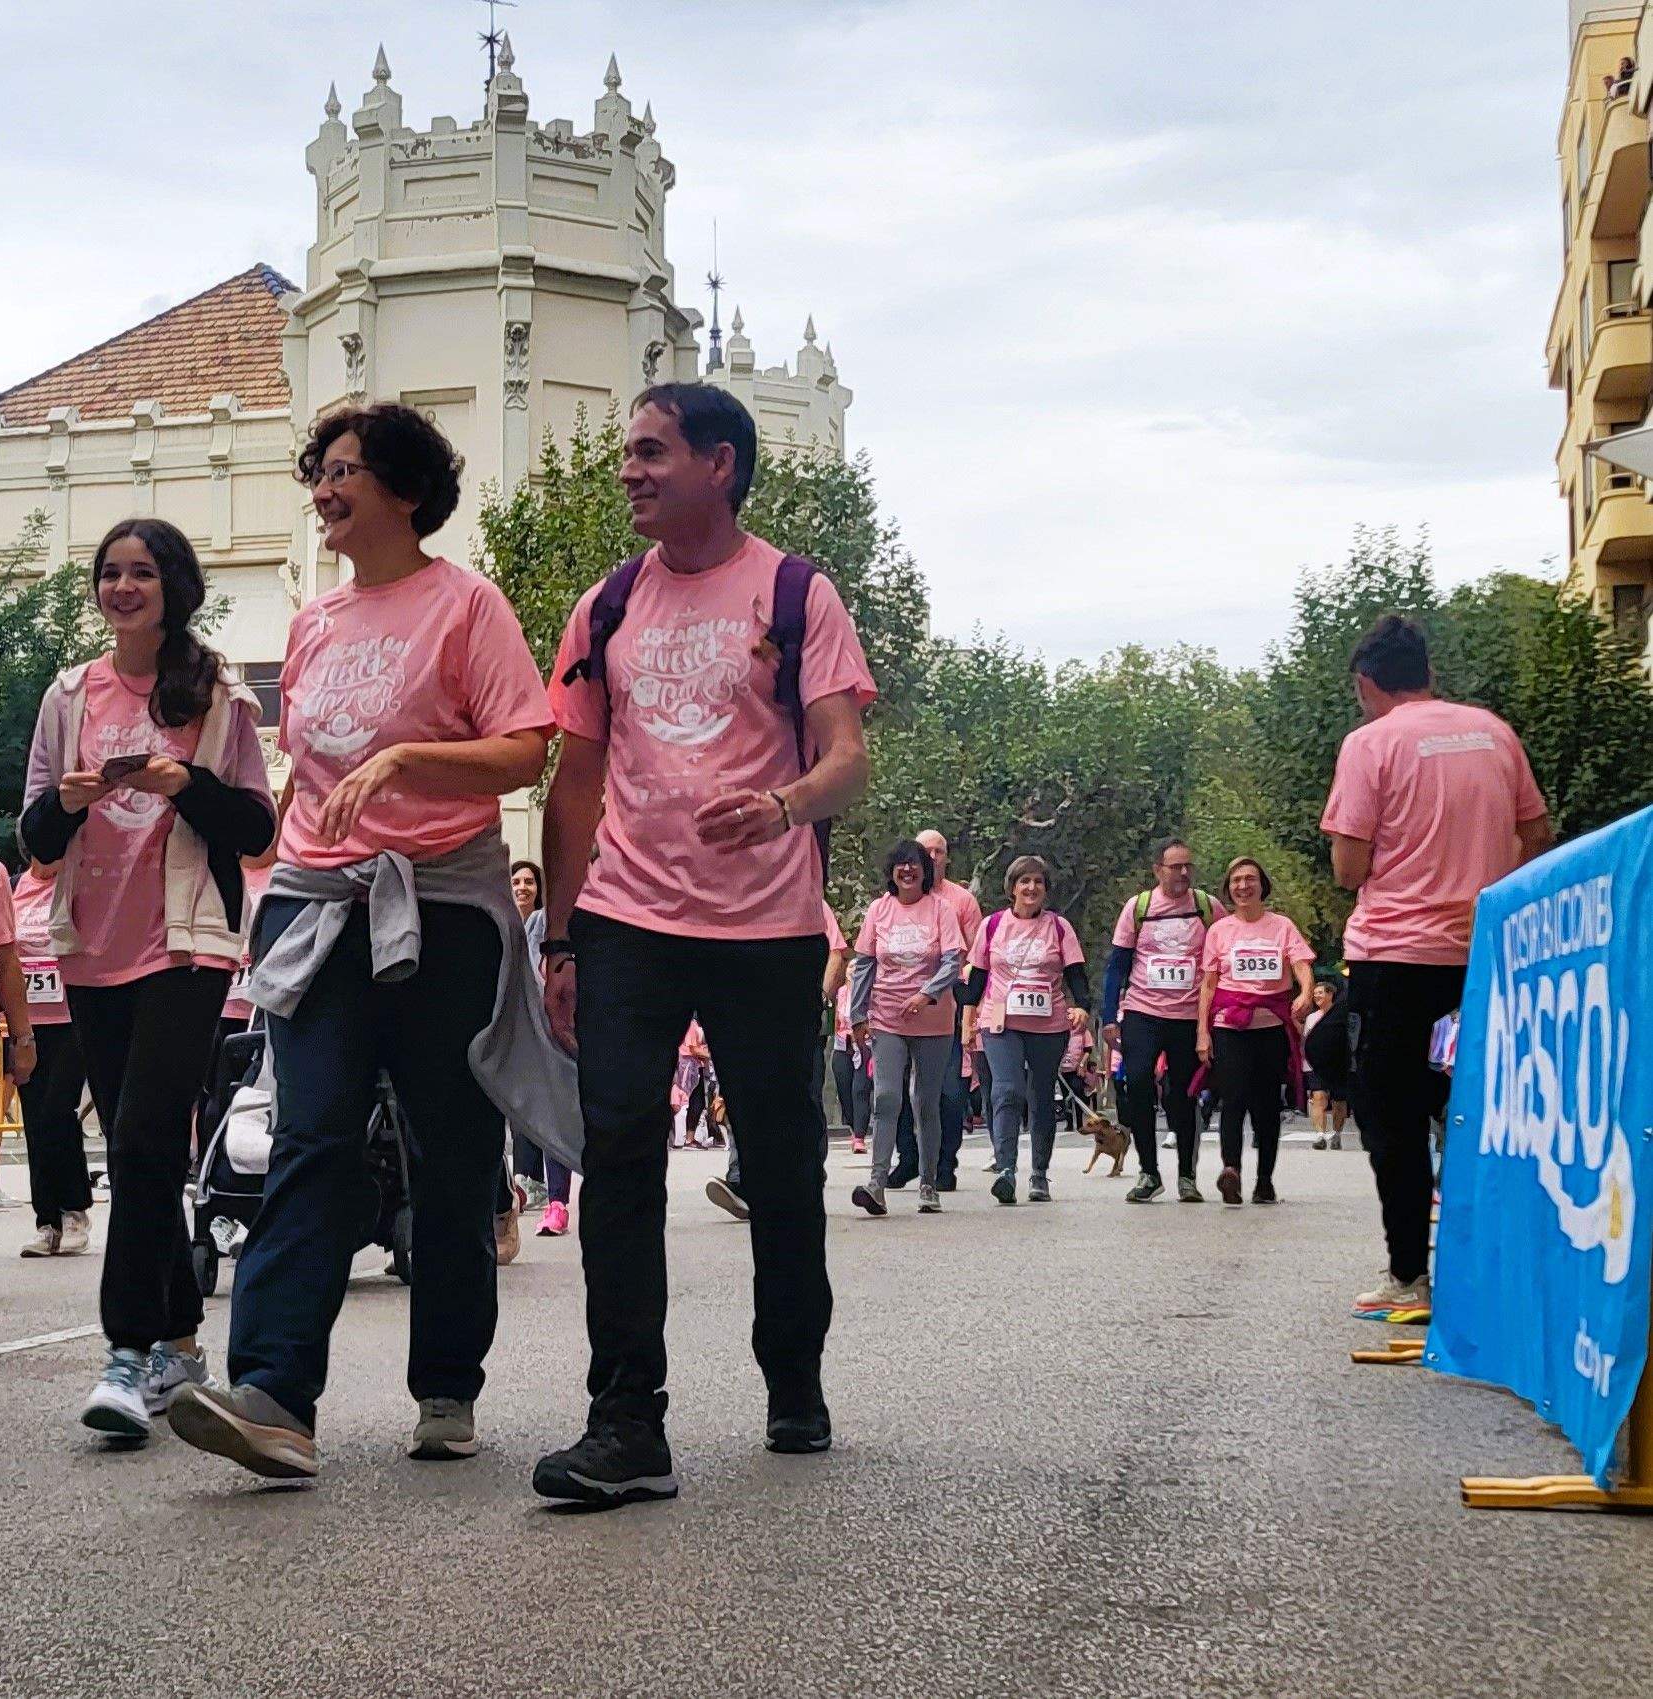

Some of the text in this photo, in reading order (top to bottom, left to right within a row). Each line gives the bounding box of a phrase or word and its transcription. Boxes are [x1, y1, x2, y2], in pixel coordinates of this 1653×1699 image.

[1235, 958, 1278, 972] 3036
[1158, 967, 1186, 981] 111
[1017, 993, 1045, 1007] 110
